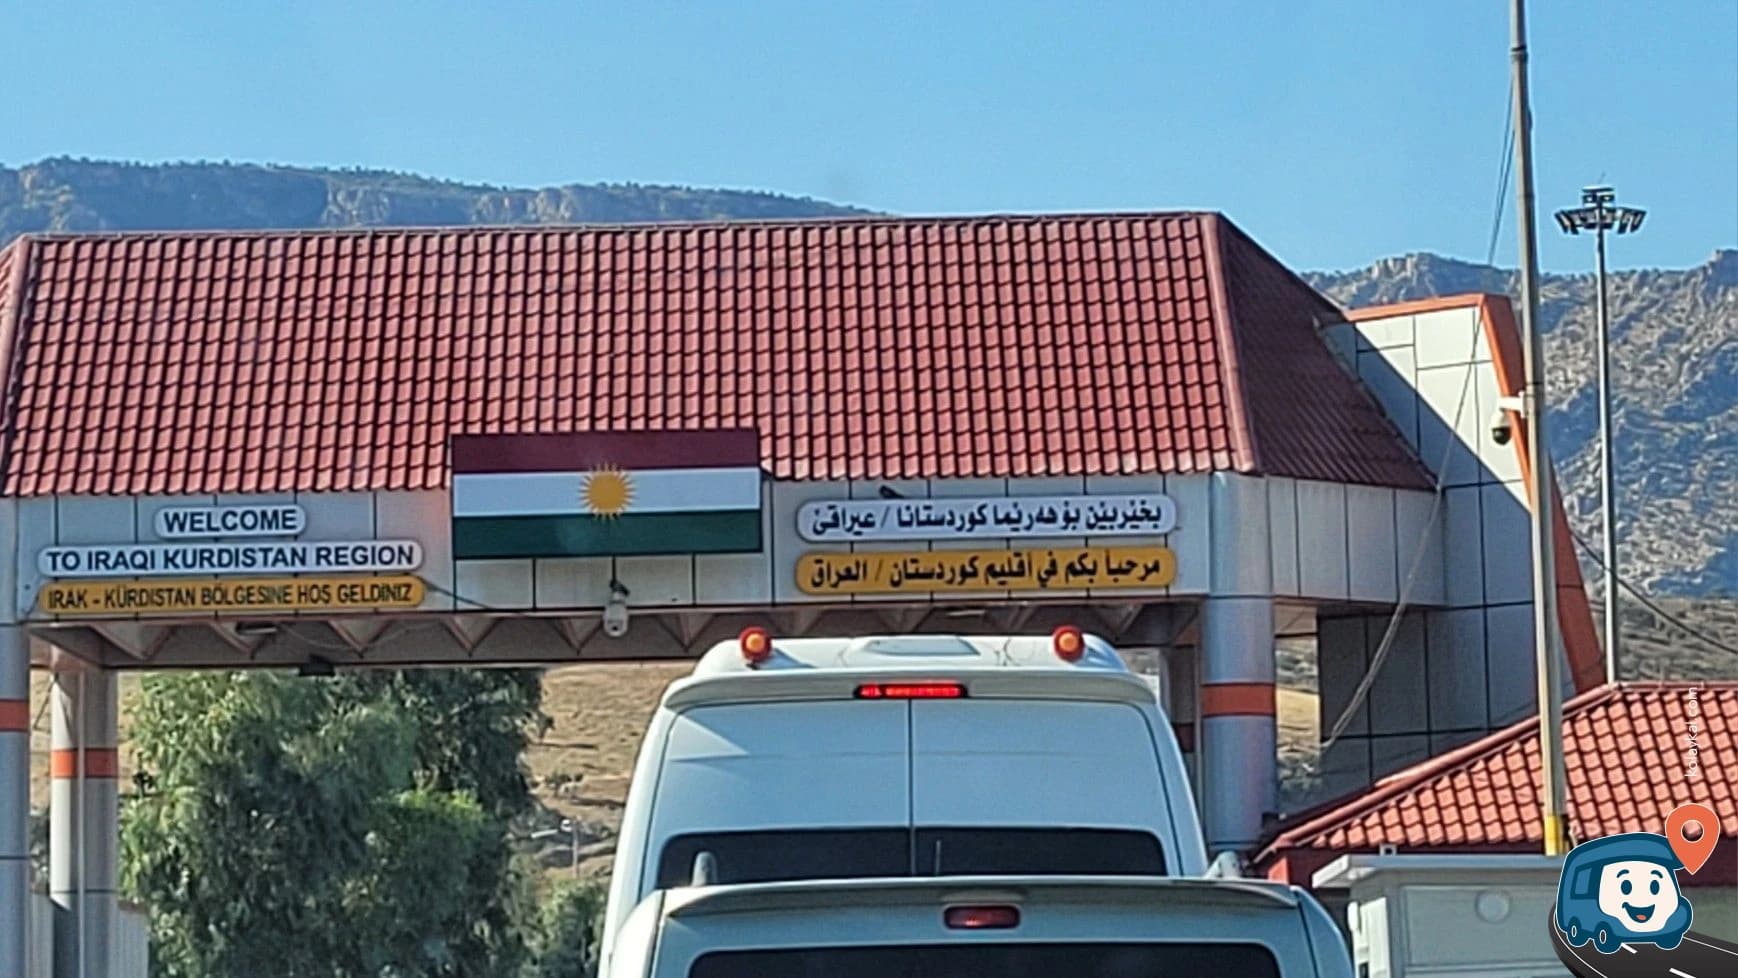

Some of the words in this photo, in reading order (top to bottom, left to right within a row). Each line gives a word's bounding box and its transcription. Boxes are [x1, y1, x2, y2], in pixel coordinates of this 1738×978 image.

[163, 508, 297, 533] WELCOME
[49, 551, 81, 572] TO
[87, 549, 156, 571] IRAQI
[164, 546, 308, 570] KURDISTAN
[316, 544, 414, 566] REGION
[1037, 551, 1058, 588] في
[1065, 552, 1098, 584] بكم
[811, 558, 867, 588] العراق
[48, 589, 88, 609] IRAK
